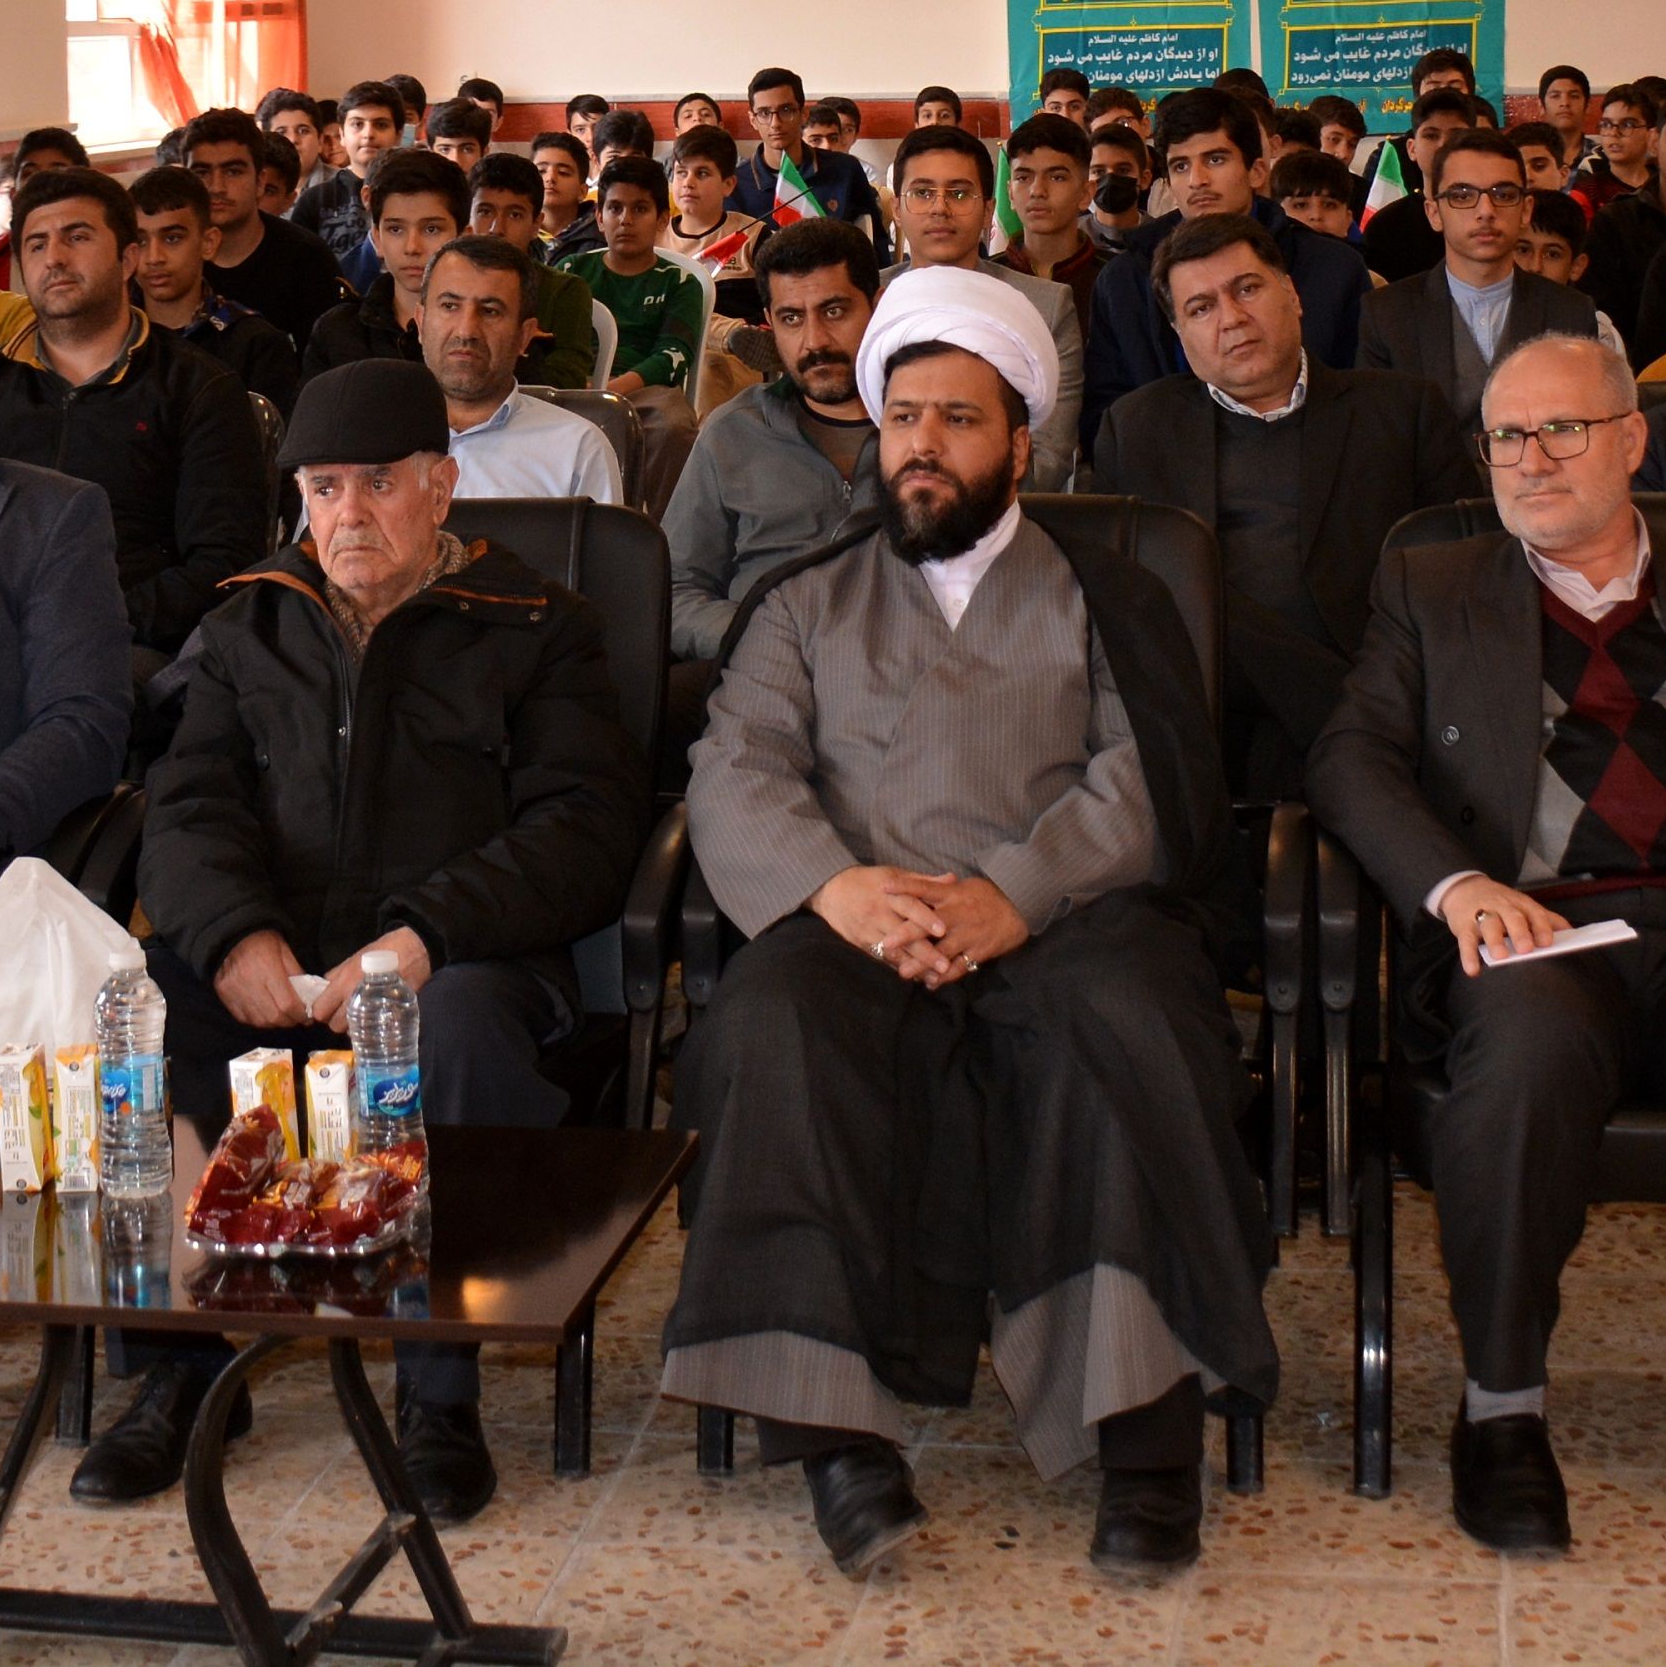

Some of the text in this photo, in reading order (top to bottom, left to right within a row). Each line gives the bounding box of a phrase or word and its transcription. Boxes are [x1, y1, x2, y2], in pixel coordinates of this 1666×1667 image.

[1118, 34, 1137, 46] علیه
[1139, 33, 1160, 46] کاظم
[1162, 32, 1178, 43] امام
[1366, 32, 1386, 44] علیه
[1387, 29, 1408, 43] کاظم
[1410, 29, 1426, 40] امام
[1095, 48, 1124, 65] غایب
[1126, 50, 1153, 65] مردم
[1155, 47, 1194, 63] دیدگان
[1197, 48, 1206, 63] از
[1208, 48, 1219, 62] او
[1343, 46, 1371, 62] غایب
[1374, 47, 1401, 63] مردم
[1088, 71, 1123, 84] مومنان
[1333, 69, 1370, 83] مومنان
